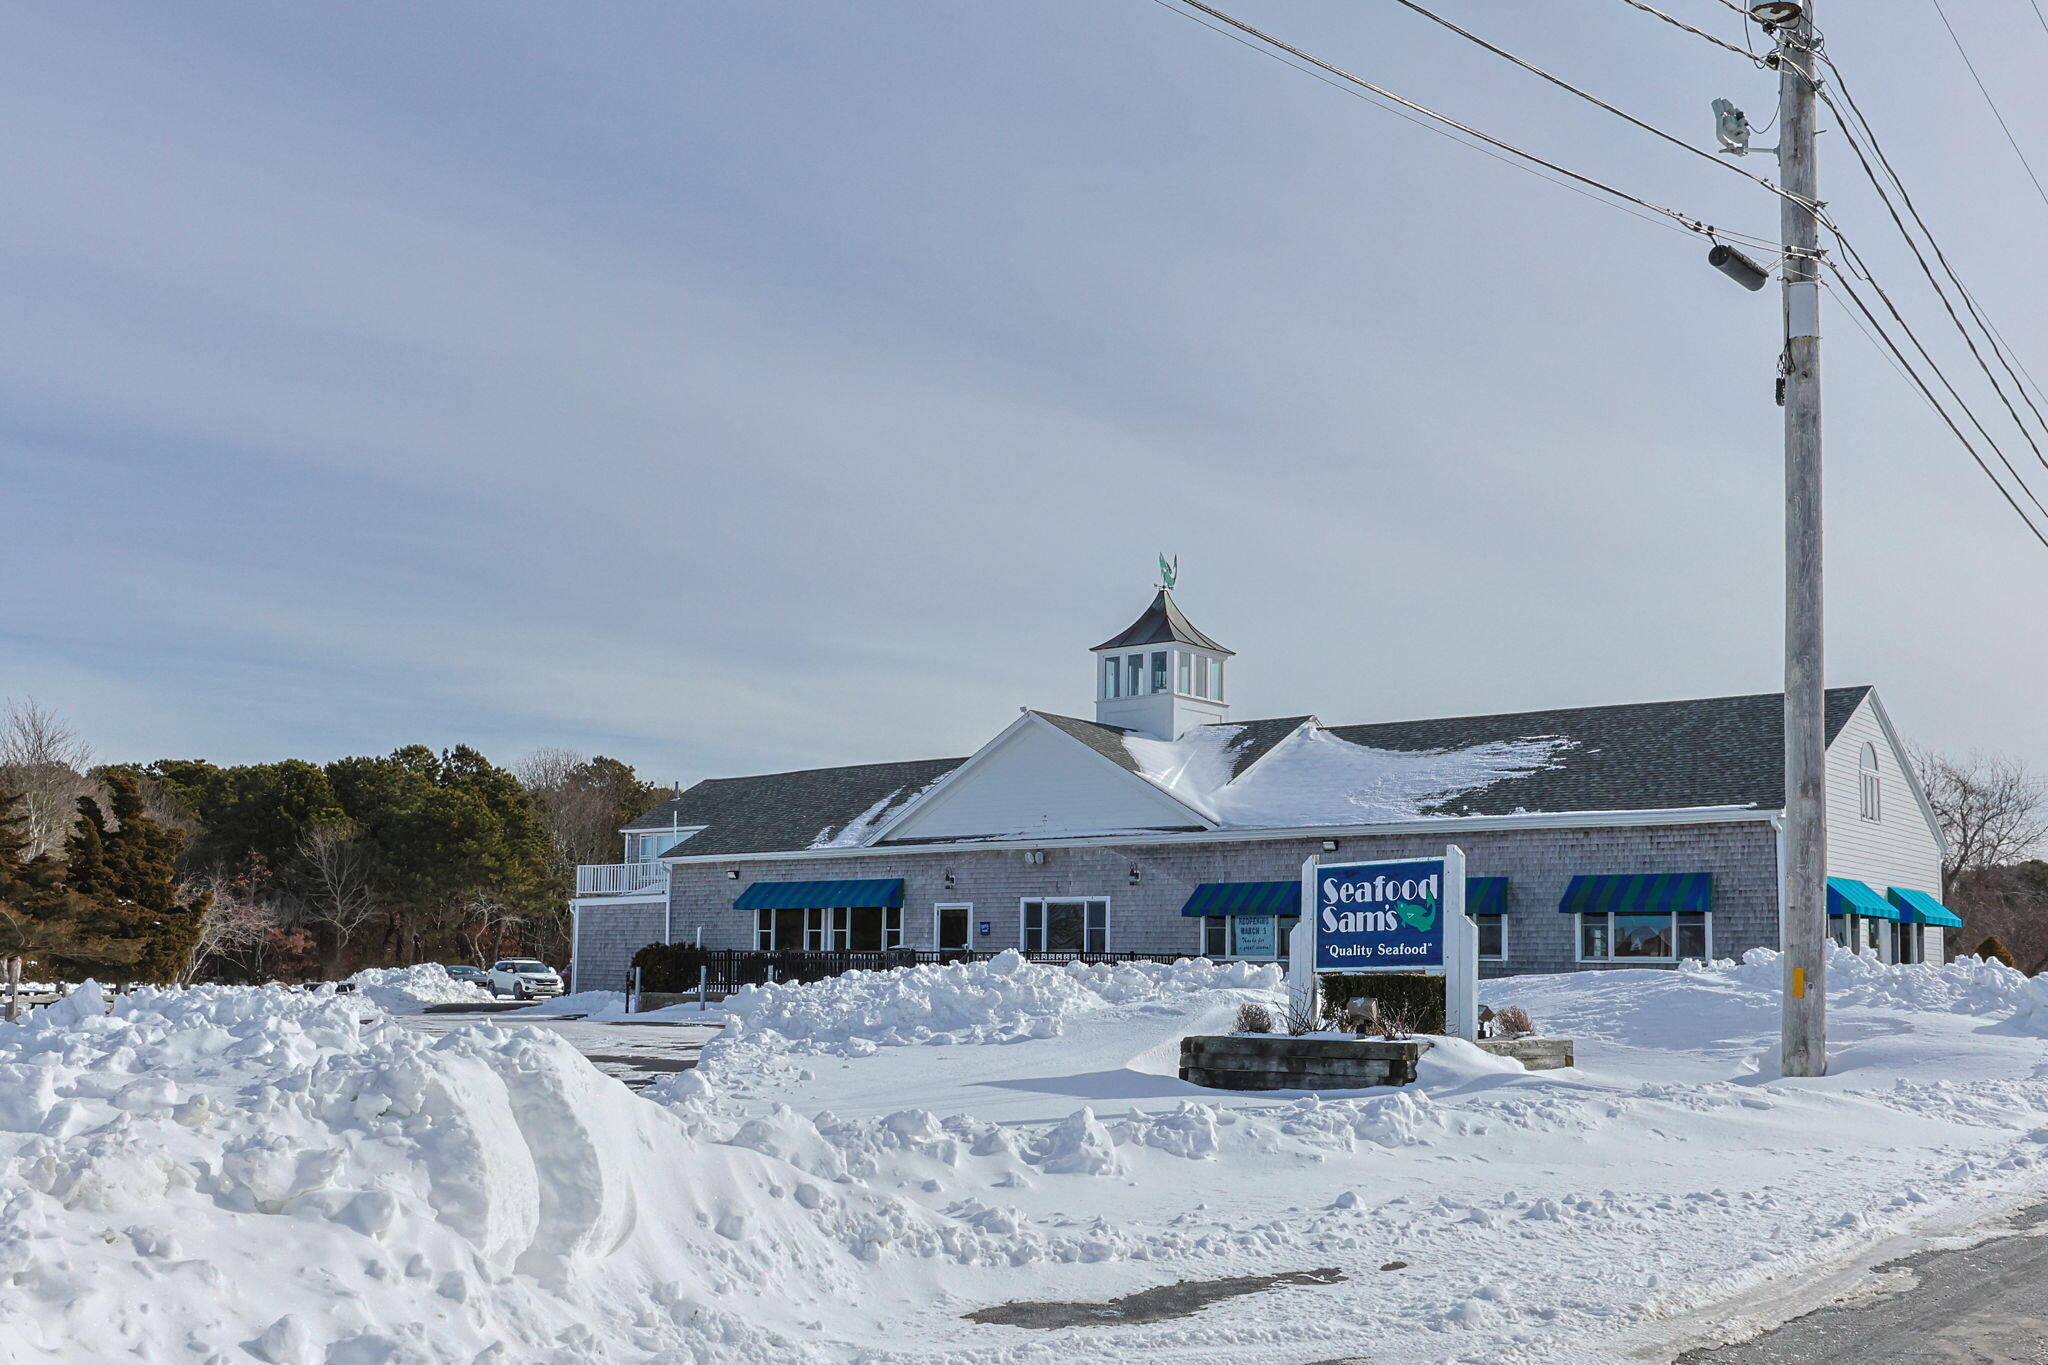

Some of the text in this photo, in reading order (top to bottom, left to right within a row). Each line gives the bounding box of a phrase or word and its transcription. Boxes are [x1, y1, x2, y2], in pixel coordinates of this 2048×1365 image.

[1323, 874, 1437, 905] Seafood
[1322, 904, 1398, 933] Sam's
[1240, 927, 1259, 935] MARCH
[1325, 943, 1433, 958] "Quality Seafood"
